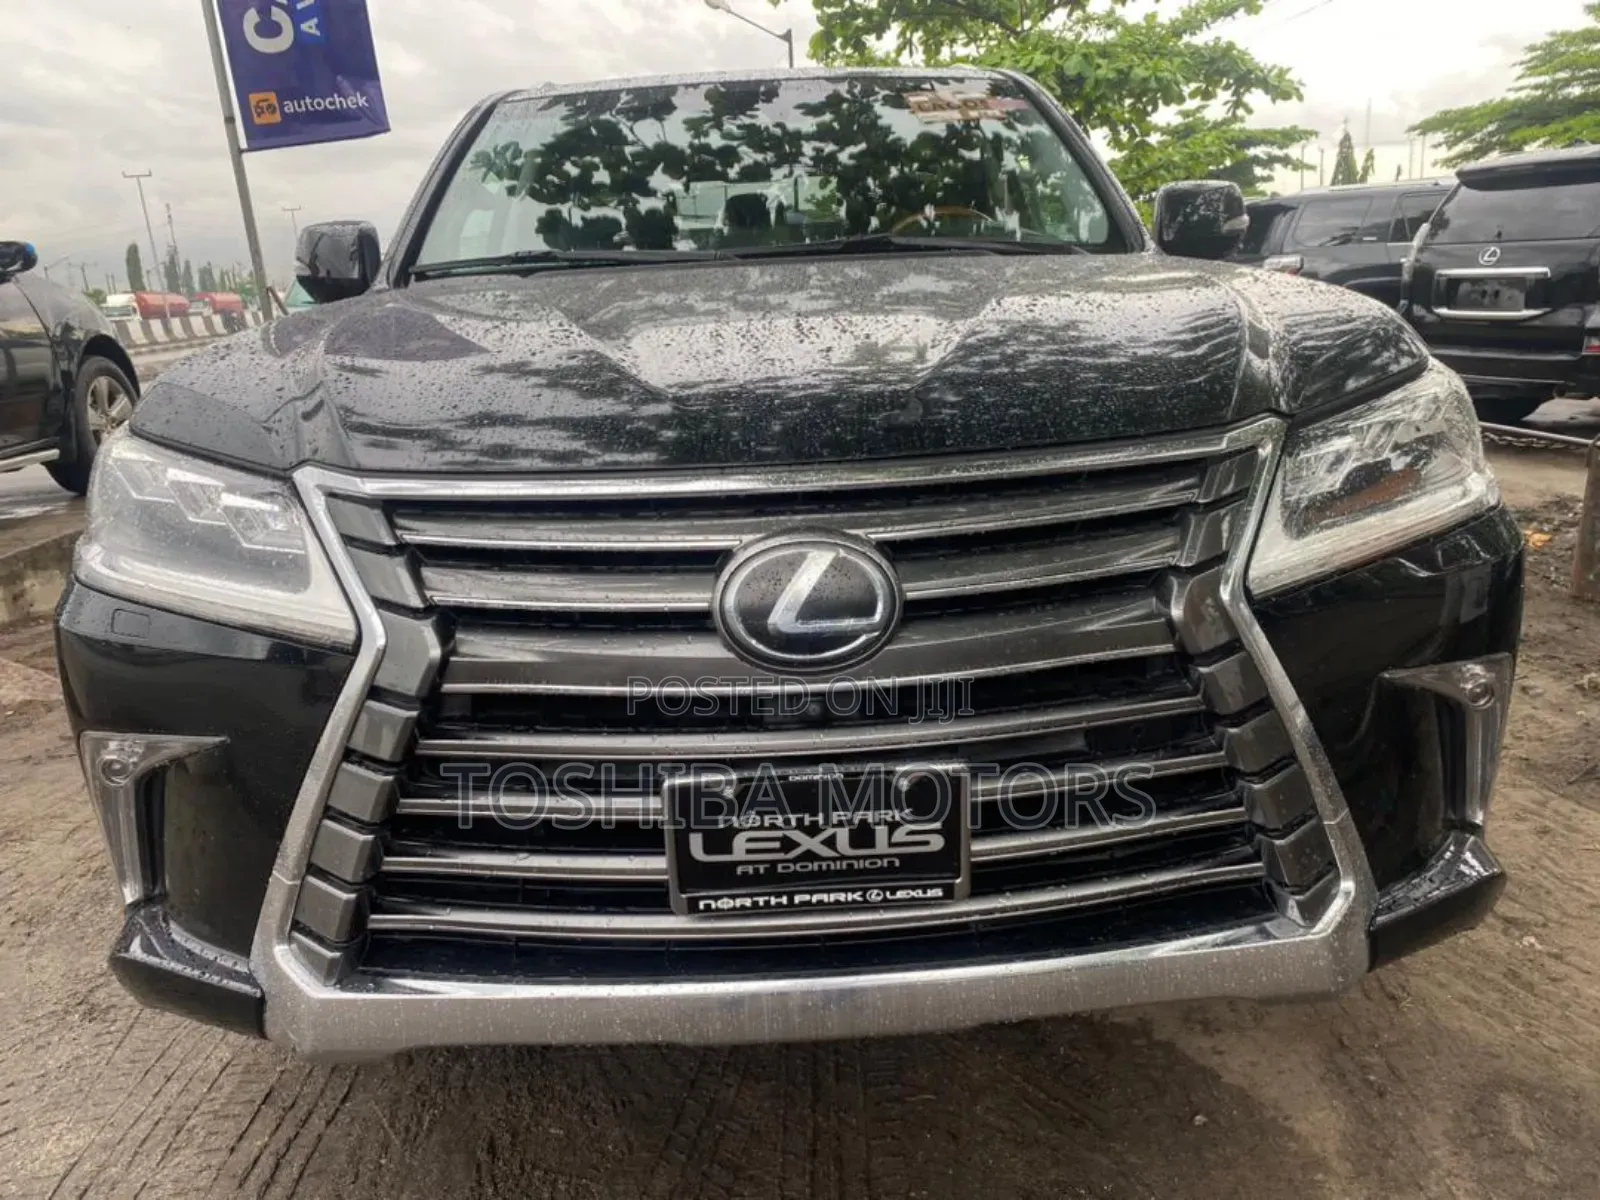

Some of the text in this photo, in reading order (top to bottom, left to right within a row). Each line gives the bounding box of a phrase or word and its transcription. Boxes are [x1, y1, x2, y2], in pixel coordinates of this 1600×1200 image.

[283, 91, 369, 114] autochek
[832, 808, 914, 826] PARK
[688, 821, 946, 862] LEXUS
[735, 857, 900, 876] AT DOMINION
[699, 887, 944, 910] NORTH PARK LEXUS
